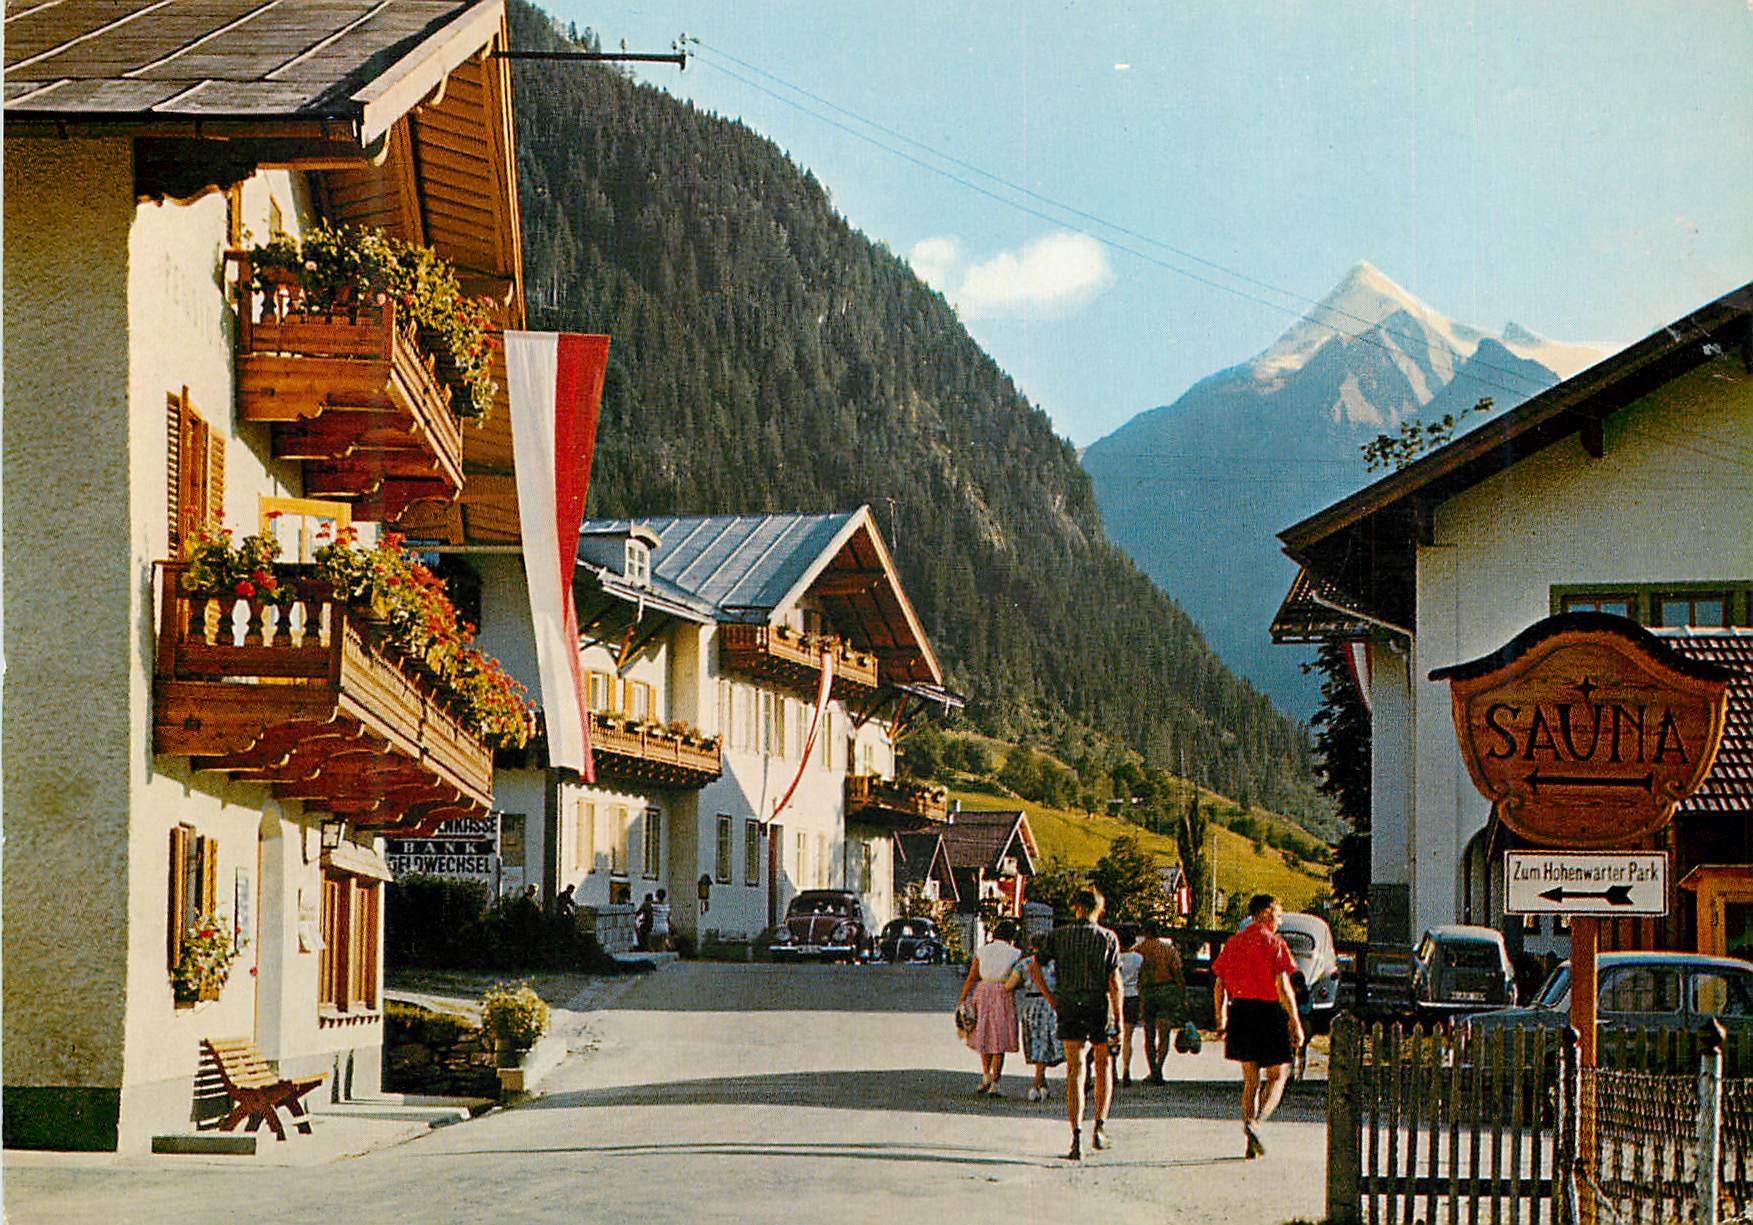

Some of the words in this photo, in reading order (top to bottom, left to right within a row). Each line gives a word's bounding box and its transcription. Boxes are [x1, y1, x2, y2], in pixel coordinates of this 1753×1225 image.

[1485, 703, 1691, 764] SAUNA
[403, 842, 478, 853] BANK
[1513, 860, 1540, 881] Zum
[1628, 860, 1659, 881] Park
